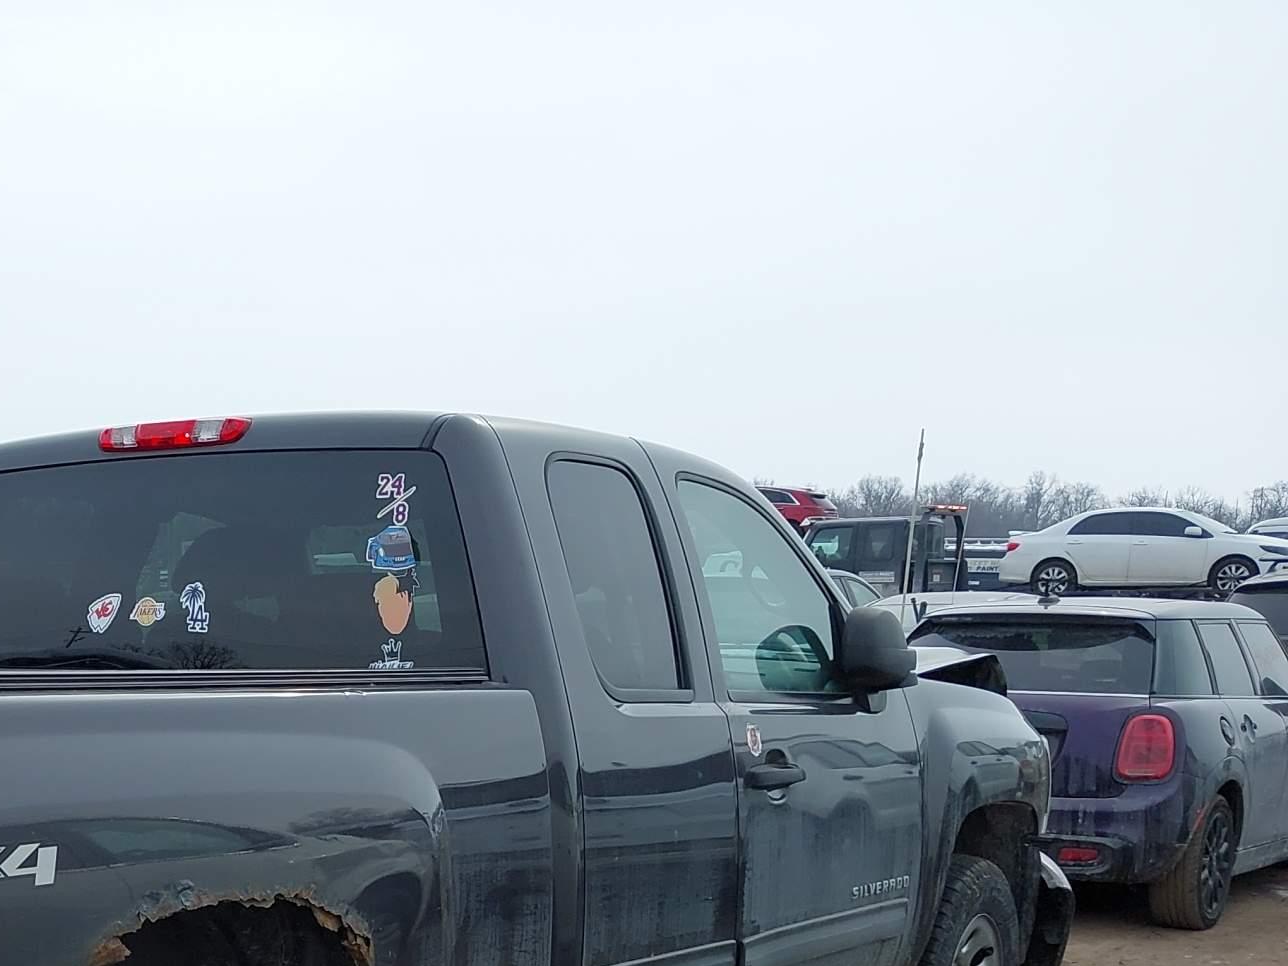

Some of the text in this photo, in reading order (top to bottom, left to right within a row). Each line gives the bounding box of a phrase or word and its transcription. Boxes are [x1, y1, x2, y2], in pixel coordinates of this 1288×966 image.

[377, 474, 404, 498] 24
[394, 502, 408, 524] 8
[852, 875, 910, 899] SILVERADO
